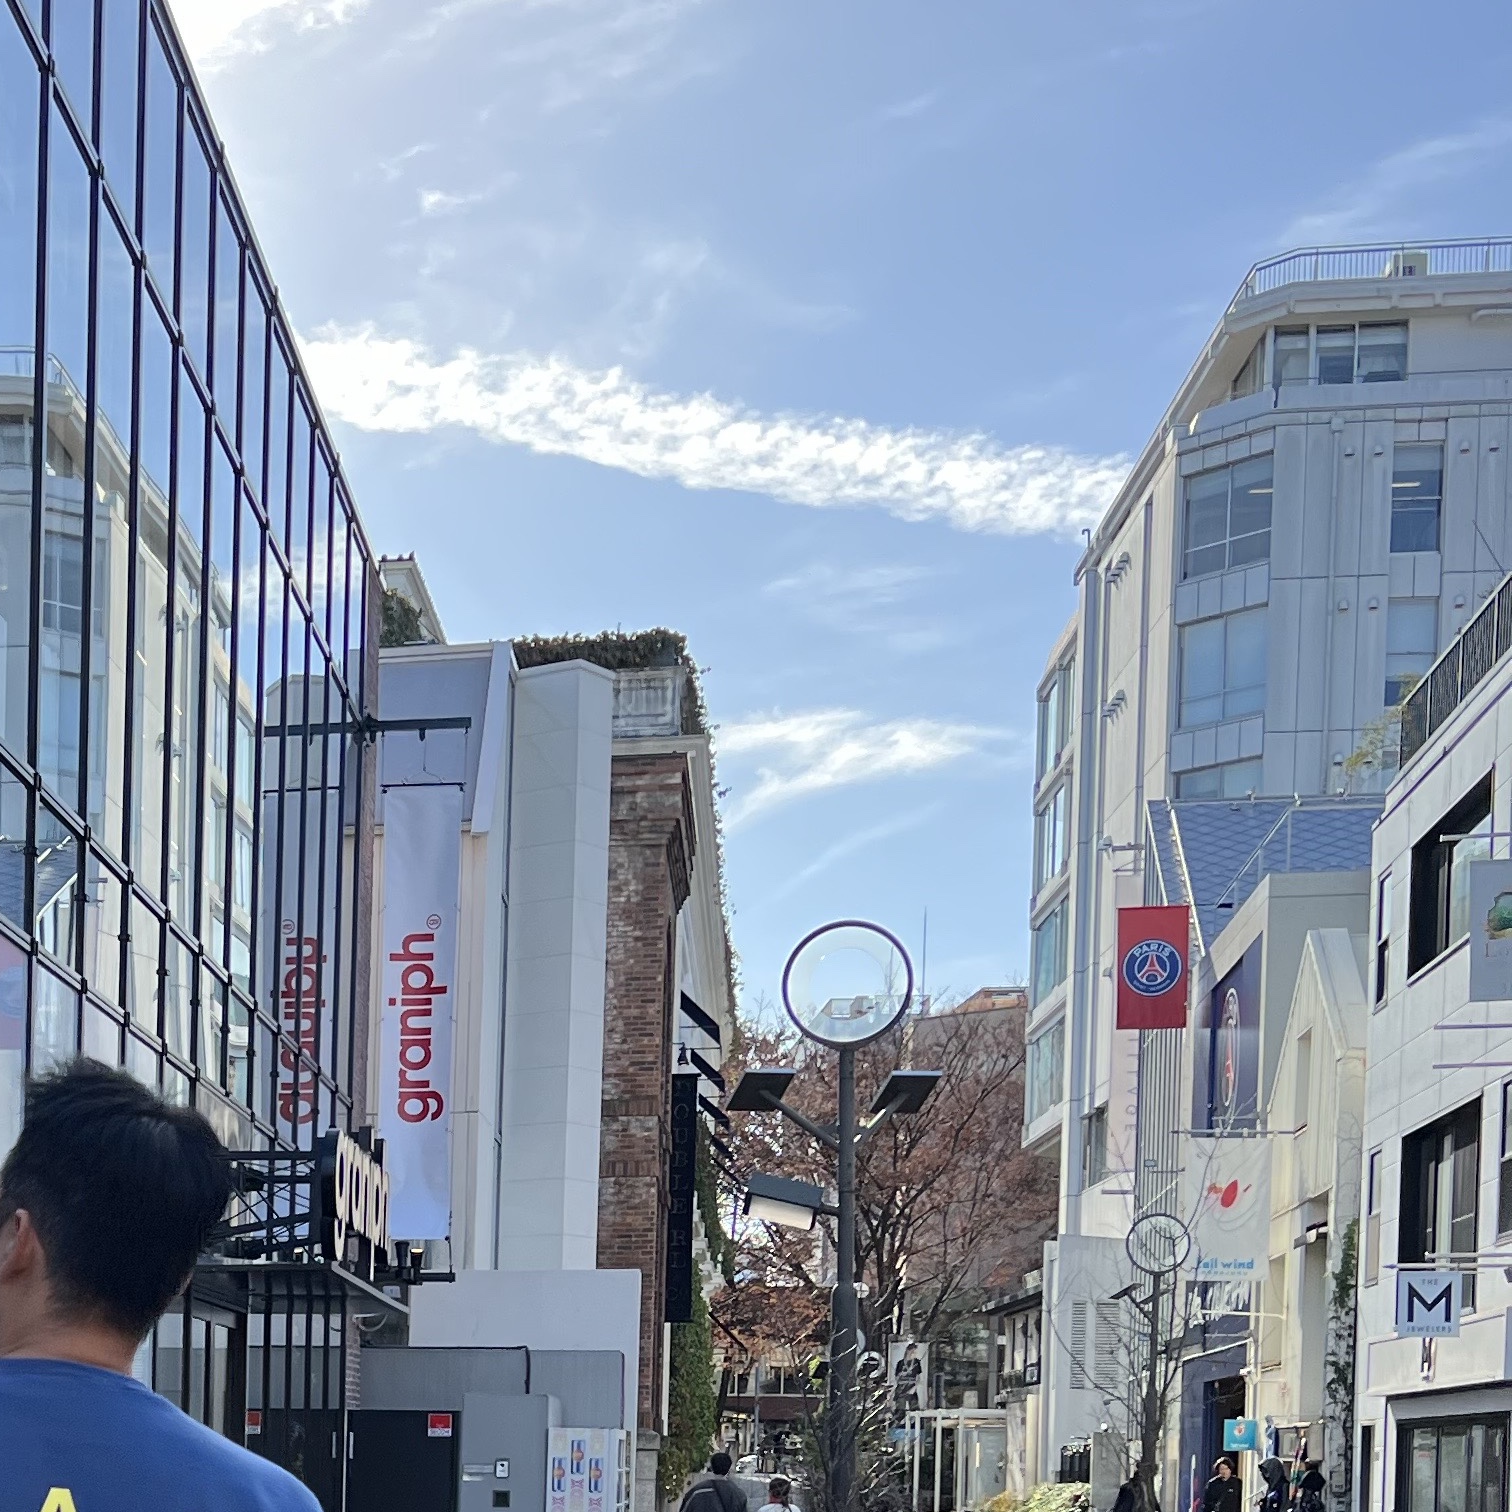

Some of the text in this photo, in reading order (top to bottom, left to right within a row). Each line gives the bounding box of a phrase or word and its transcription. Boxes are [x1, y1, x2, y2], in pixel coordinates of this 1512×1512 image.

[1133, 943, 1172, 958] PARIS
[388, 933, 448, 1123] graniph
[1221, 1257, 1255, 1269] wind
[1421, 1278, 1439, 1286] THE
[1406, 1280, 1453, 1323] M
[1406, 1325, 1453, 1334] JEWELERS
